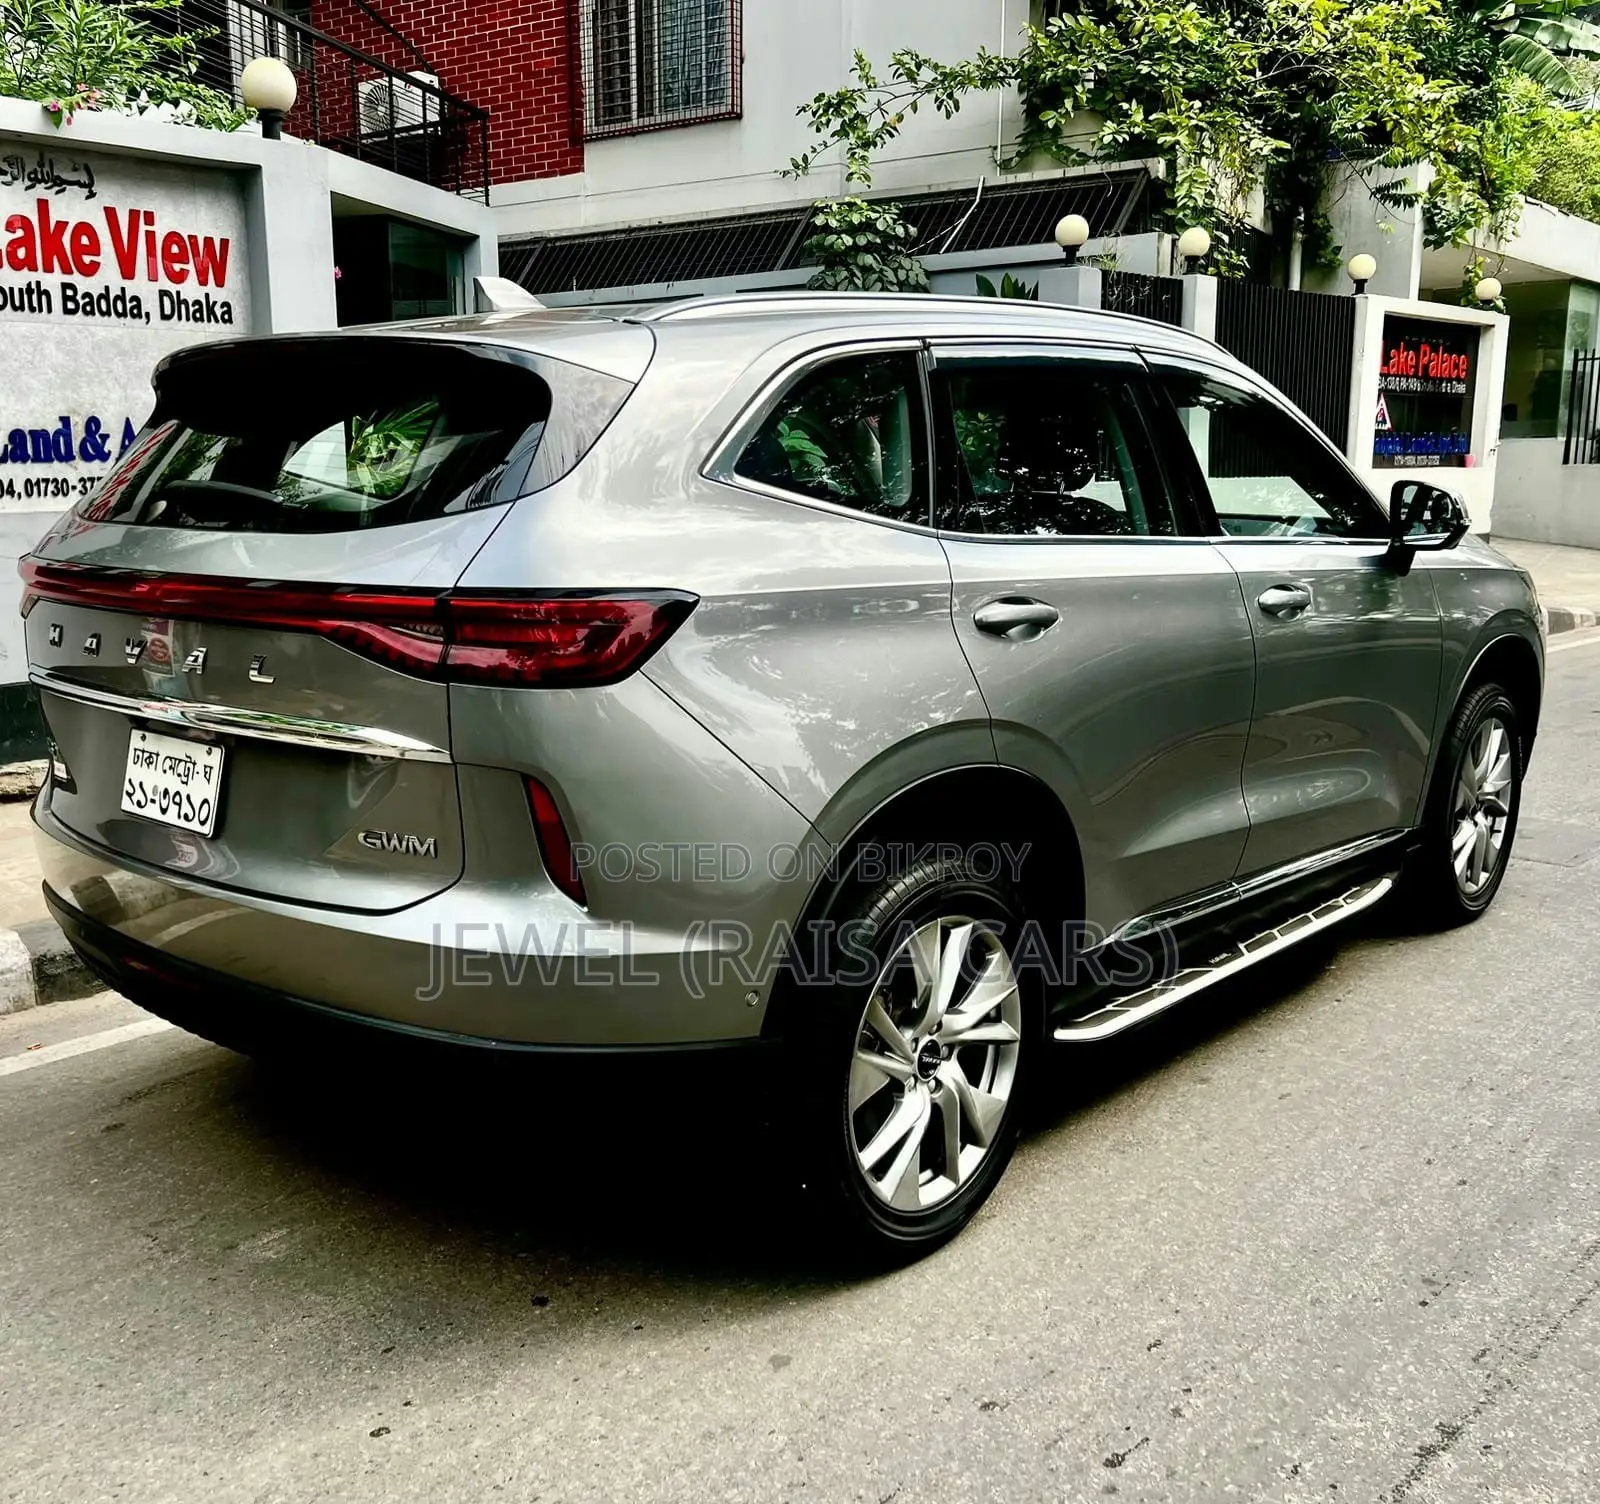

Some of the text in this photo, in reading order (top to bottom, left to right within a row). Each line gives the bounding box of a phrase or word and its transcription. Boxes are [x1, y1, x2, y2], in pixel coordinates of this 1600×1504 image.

[0, 197, 230, 288] ake View
[60, 281, 150, 325] Badda,
[159, 288, 233, 324] Dhaka
[1379, 341, 1468, 379] Lake Palace
[79, 415, 111, 463] &
[24, 476, 104, 498] 01730-37
[49, 623, 277, 685] HAVAL
[133, 748, 160, 771] ঢাকা
[125, 778, 211, 826] ২১-৩৭১০
[357, 829, 438, 859] GWM
